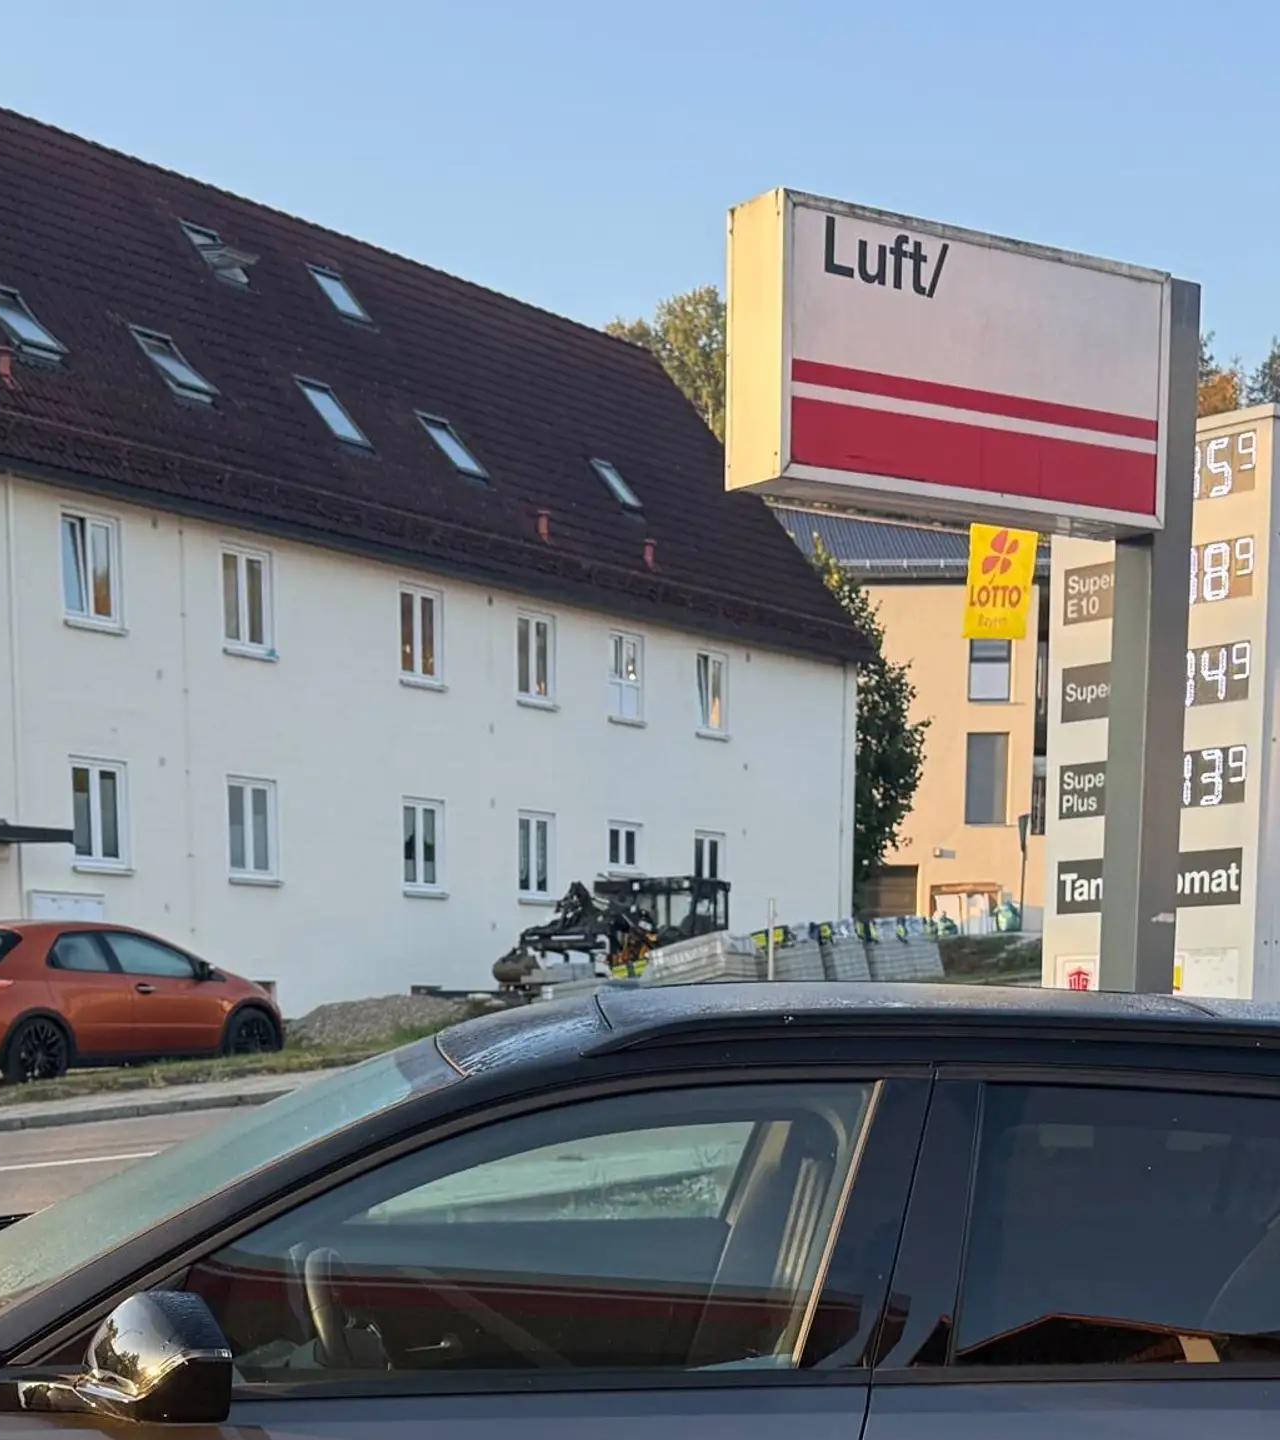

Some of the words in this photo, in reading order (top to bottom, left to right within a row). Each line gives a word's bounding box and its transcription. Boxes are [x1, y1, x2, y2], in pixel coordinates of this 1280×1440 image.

[824, 215, 950, 299] Luft/
[969, 585, 1022, 609] LOTTO
[1066, 596, 1100, 619] E10
[1063, 771, 1105, 792] Supe
[1183, 746, 1247, 806] 139
[1062, 793, 1098, 814] Plus
